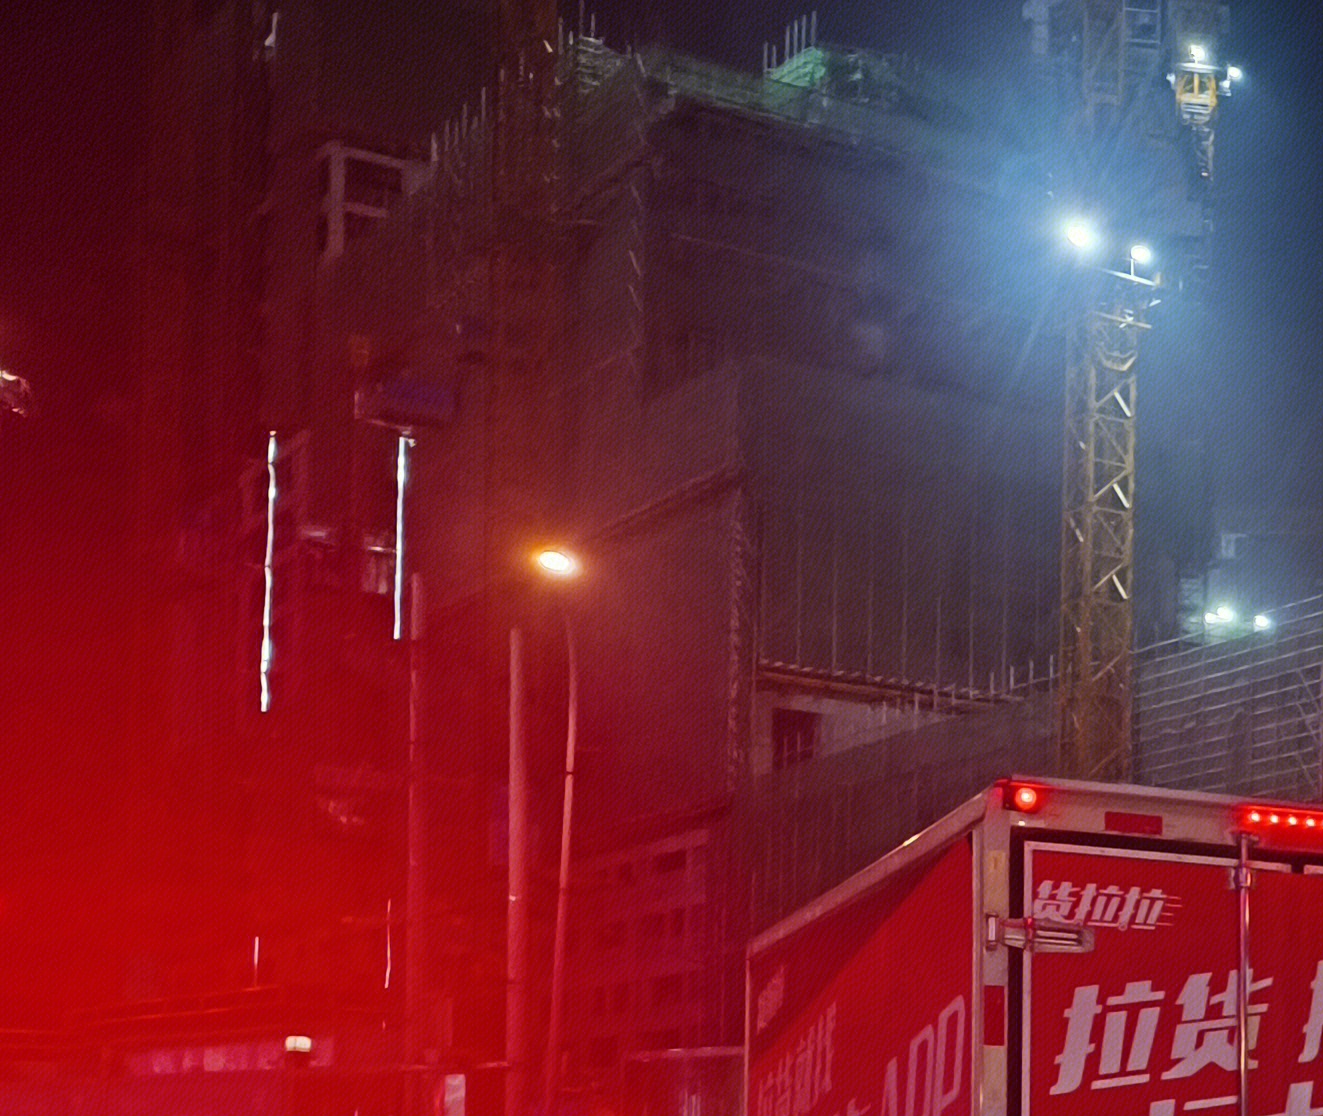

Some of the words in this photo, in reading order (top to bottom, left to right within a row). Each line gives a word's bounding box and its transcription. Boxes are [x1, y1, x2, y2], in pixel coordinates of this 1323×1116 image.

[1033, 879, 1170, 931] 货拉拉
[1050, 971, 1276, 1095] 拉货
